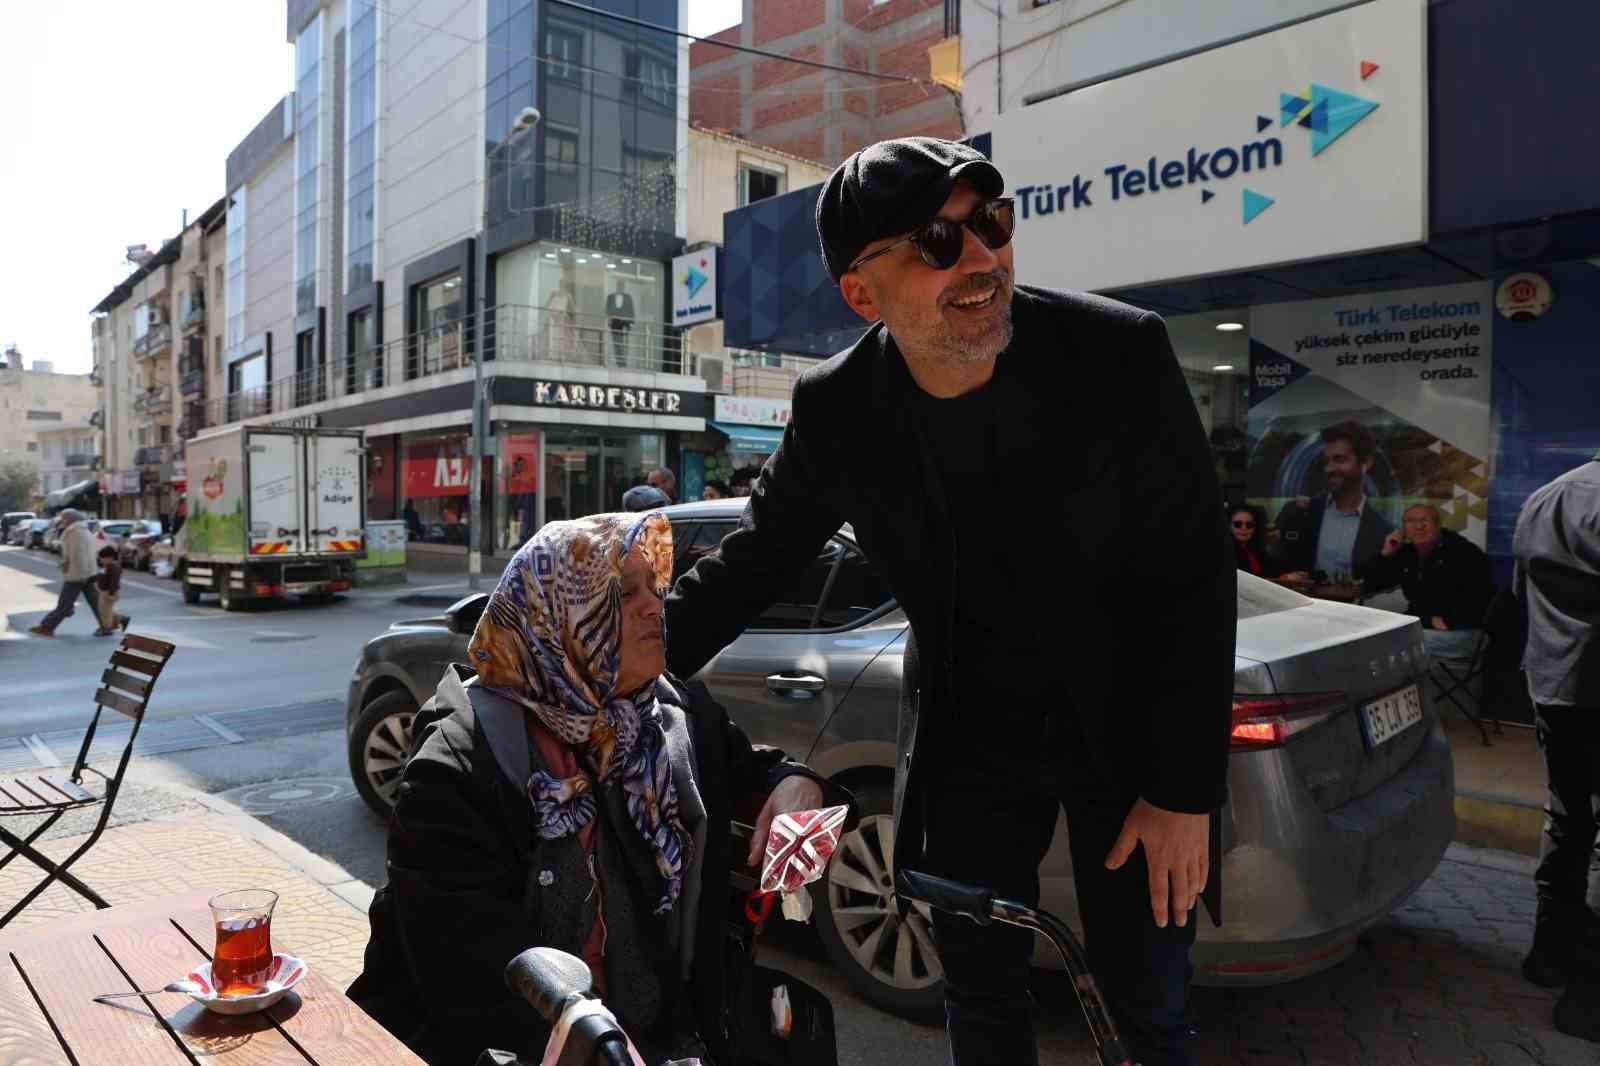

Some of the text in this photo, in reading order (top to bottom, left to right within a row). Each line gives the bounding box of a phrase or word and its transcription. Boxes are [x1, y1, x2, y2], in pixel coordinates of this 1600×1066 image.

[1016, 136, 1283, 219] Türk Telekom
[1335, 301, 1480, 328] Türk Telekom
[1294, 322, 1481, 353] yüksek çekim gücüyle
[1336, 344, 1481, 366] siz neredeyseniz
[1255, 363, 1291, 377] Mobil
[1419, 365, 1478, 381] orada.
